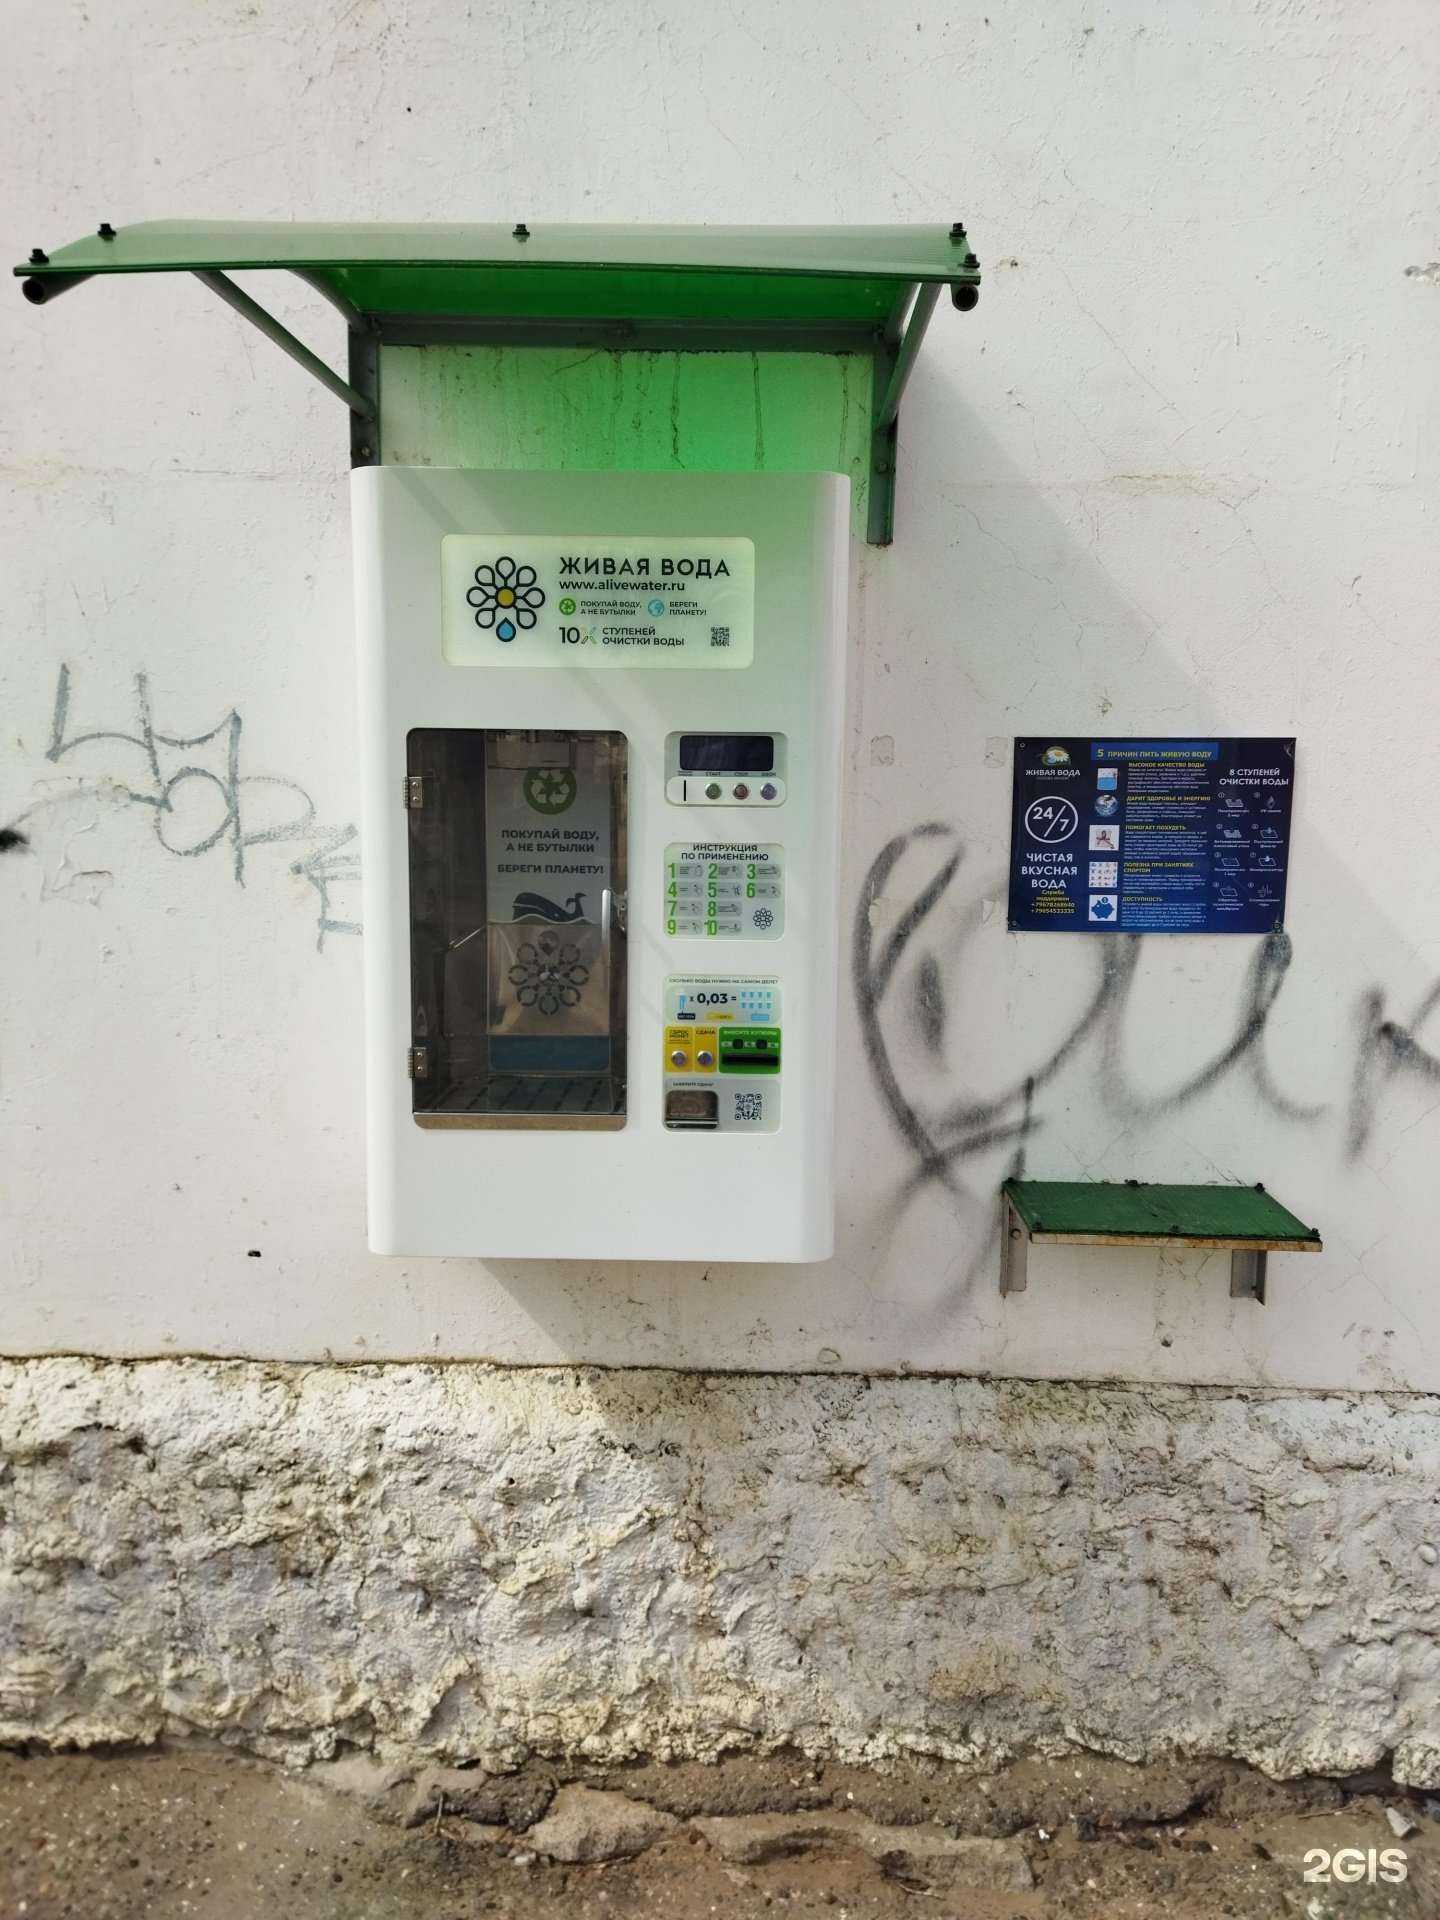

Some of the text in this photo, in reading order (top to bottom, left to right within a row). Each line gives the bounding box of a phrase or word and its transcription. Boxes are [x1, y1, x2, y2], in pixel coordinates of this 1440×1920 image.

[559, 556, 731, 579] ЖИВАЯ ВОДА
[559, 579, 686, 591] www.alivewater.ru
[580, 600, 642, 609] ПОКУПАЙ ВОДУ,
[602, 626, 656, 636] СТУПЕНЕЙ
[602, 637, 685, 647] ОЧИСТКИ ВОДЫ
[1097, 748, 1105, 758] 5
[1057, 769, 1081, 777] ВОДА
[1237, 767, 1280, 776] СТУПЕНЕЙ
[1262, 778, 1289, 786] ВОДЫ
[501, 828, 600, 840] ПОКУПАЙ ВОДУ,
[506, 843, 595, 852] А НЕ БУТЫЛКИ
[693, 843, 758, 853] ИНСТРУКЦИЯ
[681, 853, 769, 861] ПО ПРИМЕНЕНИЮ
[1026, 853, 1073, 862] ЧИСТАЯ
[497, 864, 604, 874] БЕРЕГИ ПЛАНЕТУ!
[668, 863, 675, 878] 1
[708, 863, 718, 879] 2
[747, 863, 756, 879] 3
[1021, 866, 1078, 875] ВКУСНАЯ
[1031, 879, 1067, 889] ВОДА
[668, 882, 677, 898] 4
[708, 882, 717, 898] 5
[746, 882, 756, 898] 6
[667, 900, 677, 916] 7
[708, 901, 717, 917] 8
[667, 919, 676, 935] 9
[704, 919, 717, 936] 10
[696, 992, 728, 1005] 0,03
